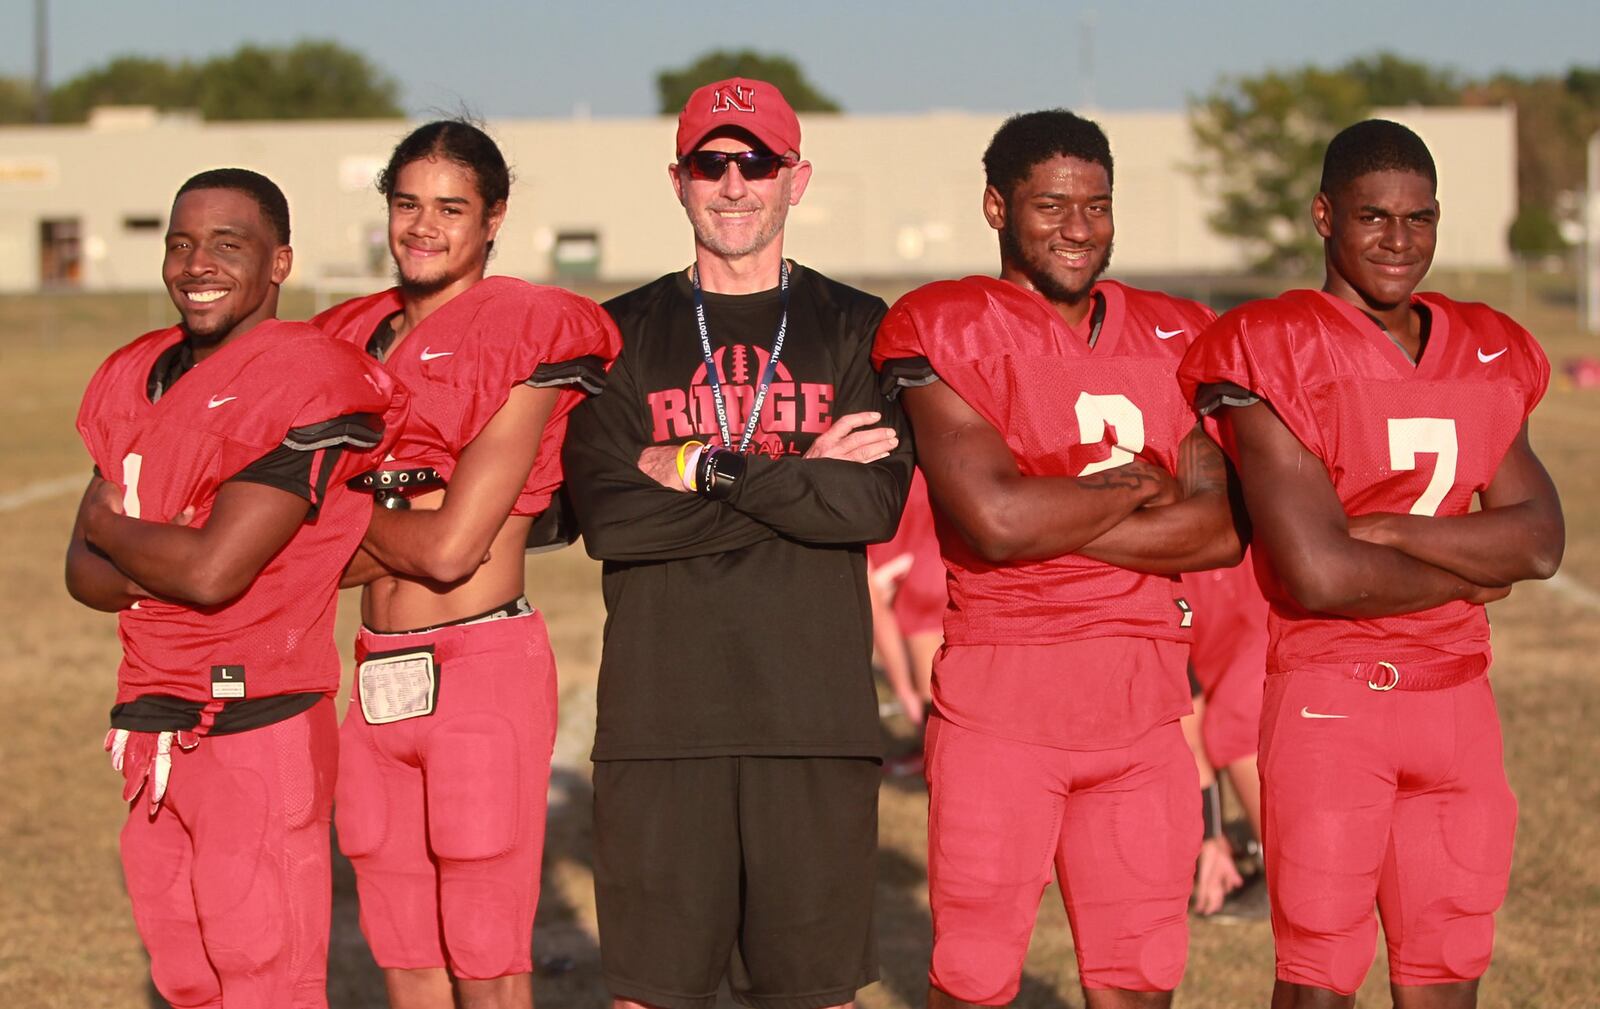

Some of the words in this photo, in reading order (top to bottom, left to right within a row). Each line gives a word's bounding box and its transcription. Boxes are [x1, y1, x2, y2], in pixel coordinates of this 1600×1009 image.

[712, 85, 755, 113] N
[647, 381, 834, 443] RIDGE
[1074, 391, 1145, 477] 2
[1387, 417, 1458, 517] 7
[222, 668, 233, 680] L
